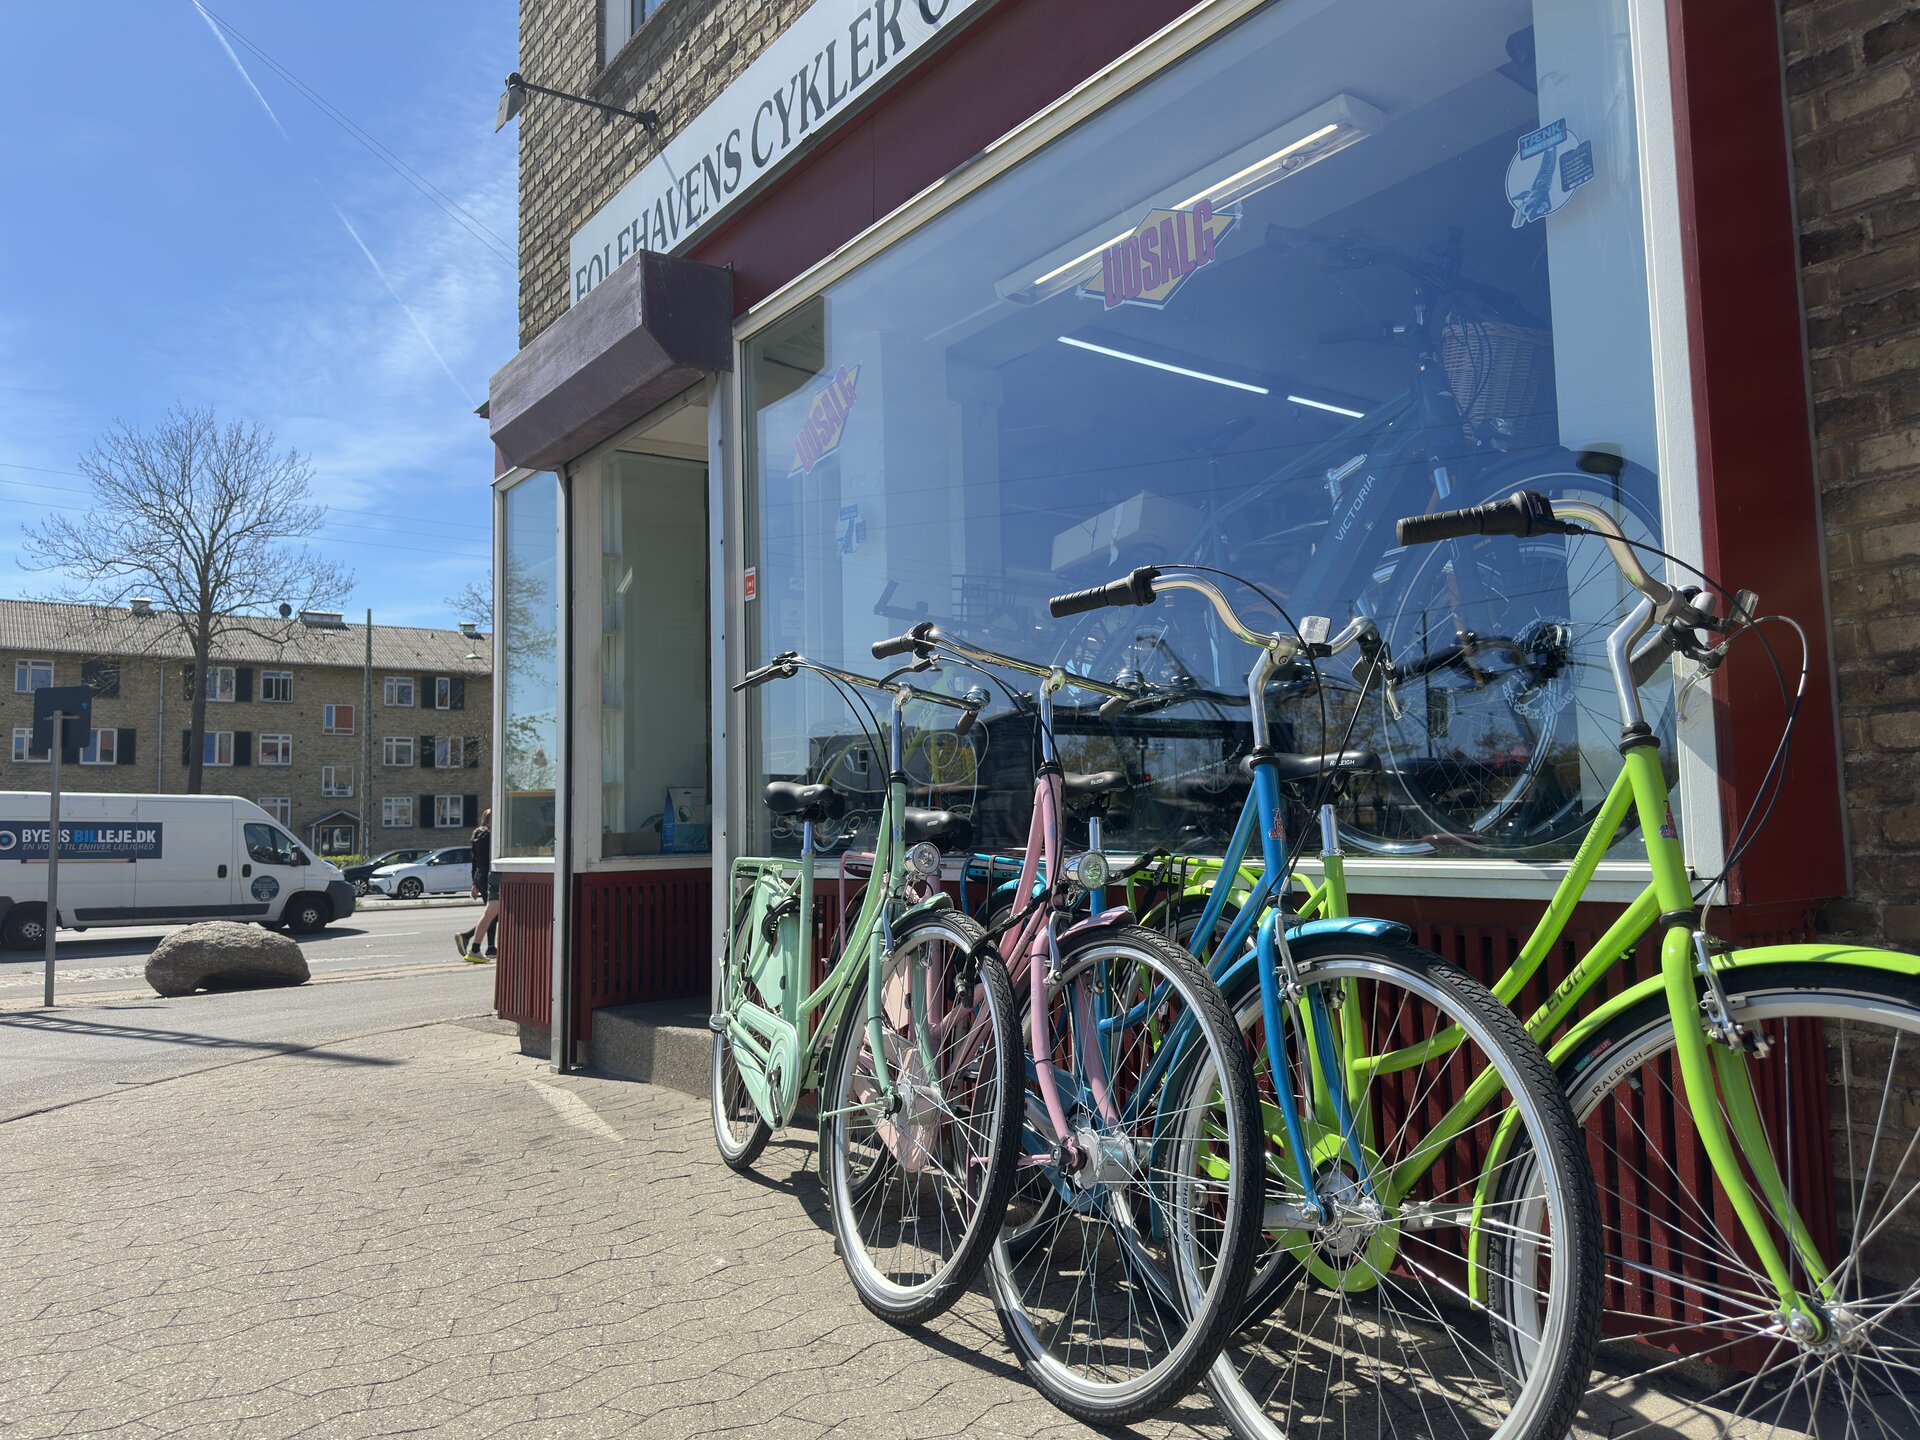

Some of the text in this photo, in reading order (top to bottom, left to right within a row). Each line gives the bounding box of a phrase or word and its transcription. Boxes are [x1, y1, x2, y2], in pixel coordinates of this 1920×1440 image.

[576, 0, 906, 303] FOLEHAVENS CYKLER
[1520, 122, 1562, 148] TÆNK
[1101, 198, 1215, 308] UDSALG
[793, 366, 858, 473] UDSALG
[1335, 474, 1376, 542] VICTORIA
[1330, 759, 1355, 767] REIGH
[22, 829, 156, 843] BYES BILLEJE.DK
[113, 843, 155, 851] LEJLIGHED
[1528, 962, 1586, 1033] ALEIGH
[1592, 1051, 1643, 1097] RALEIGH
